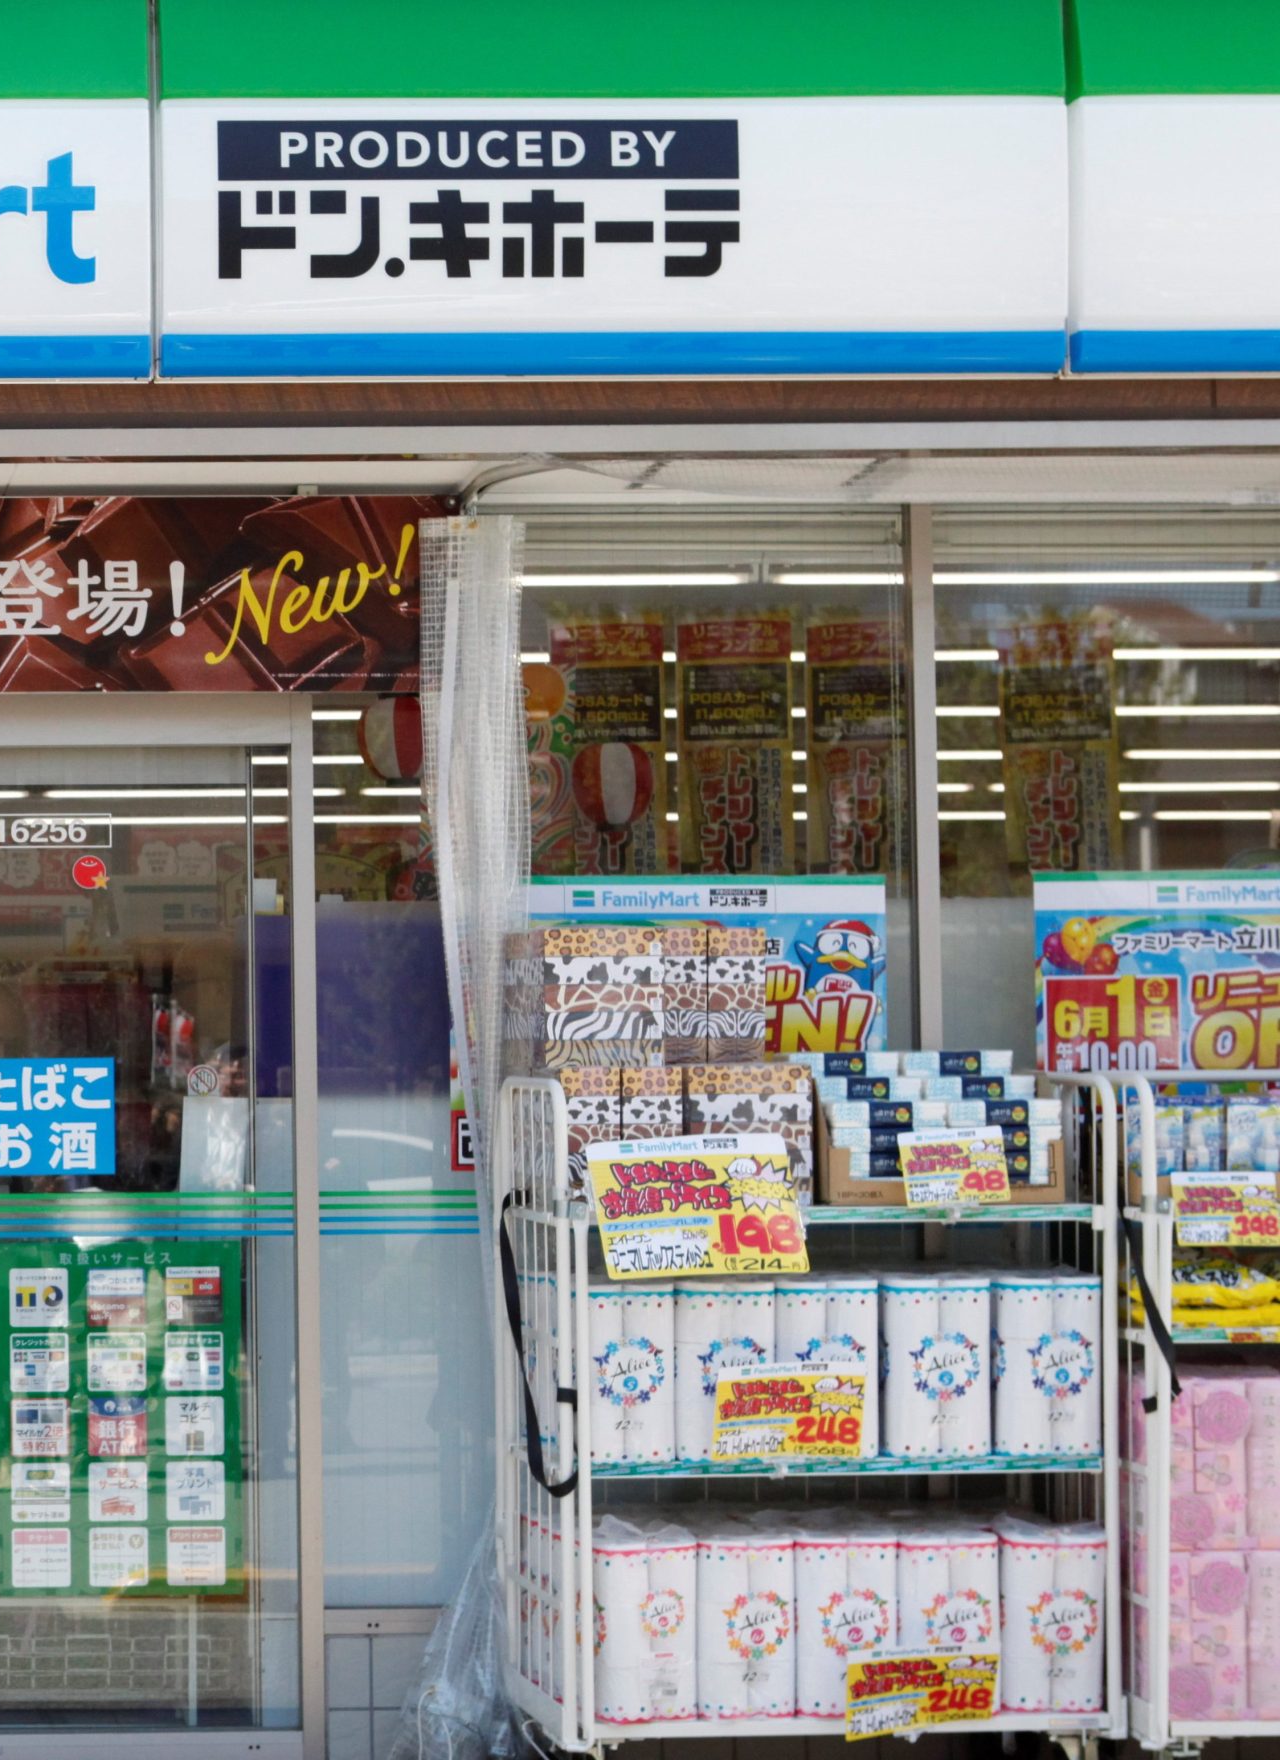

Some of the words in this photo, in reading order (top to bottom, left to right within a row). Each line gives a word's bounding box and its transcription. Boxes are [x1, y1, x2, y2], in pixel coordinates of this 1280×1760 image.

[280, 130, 587, 169] PRODUCED
[611, 129, 677, 168] BY
[601, 890, 700, 909] FamilyMart
[1114, 934, 1231, 951] ファミリーマート
[796, 1414, 861, 1445] 248
[927, 1687, 993, 1713] 248
